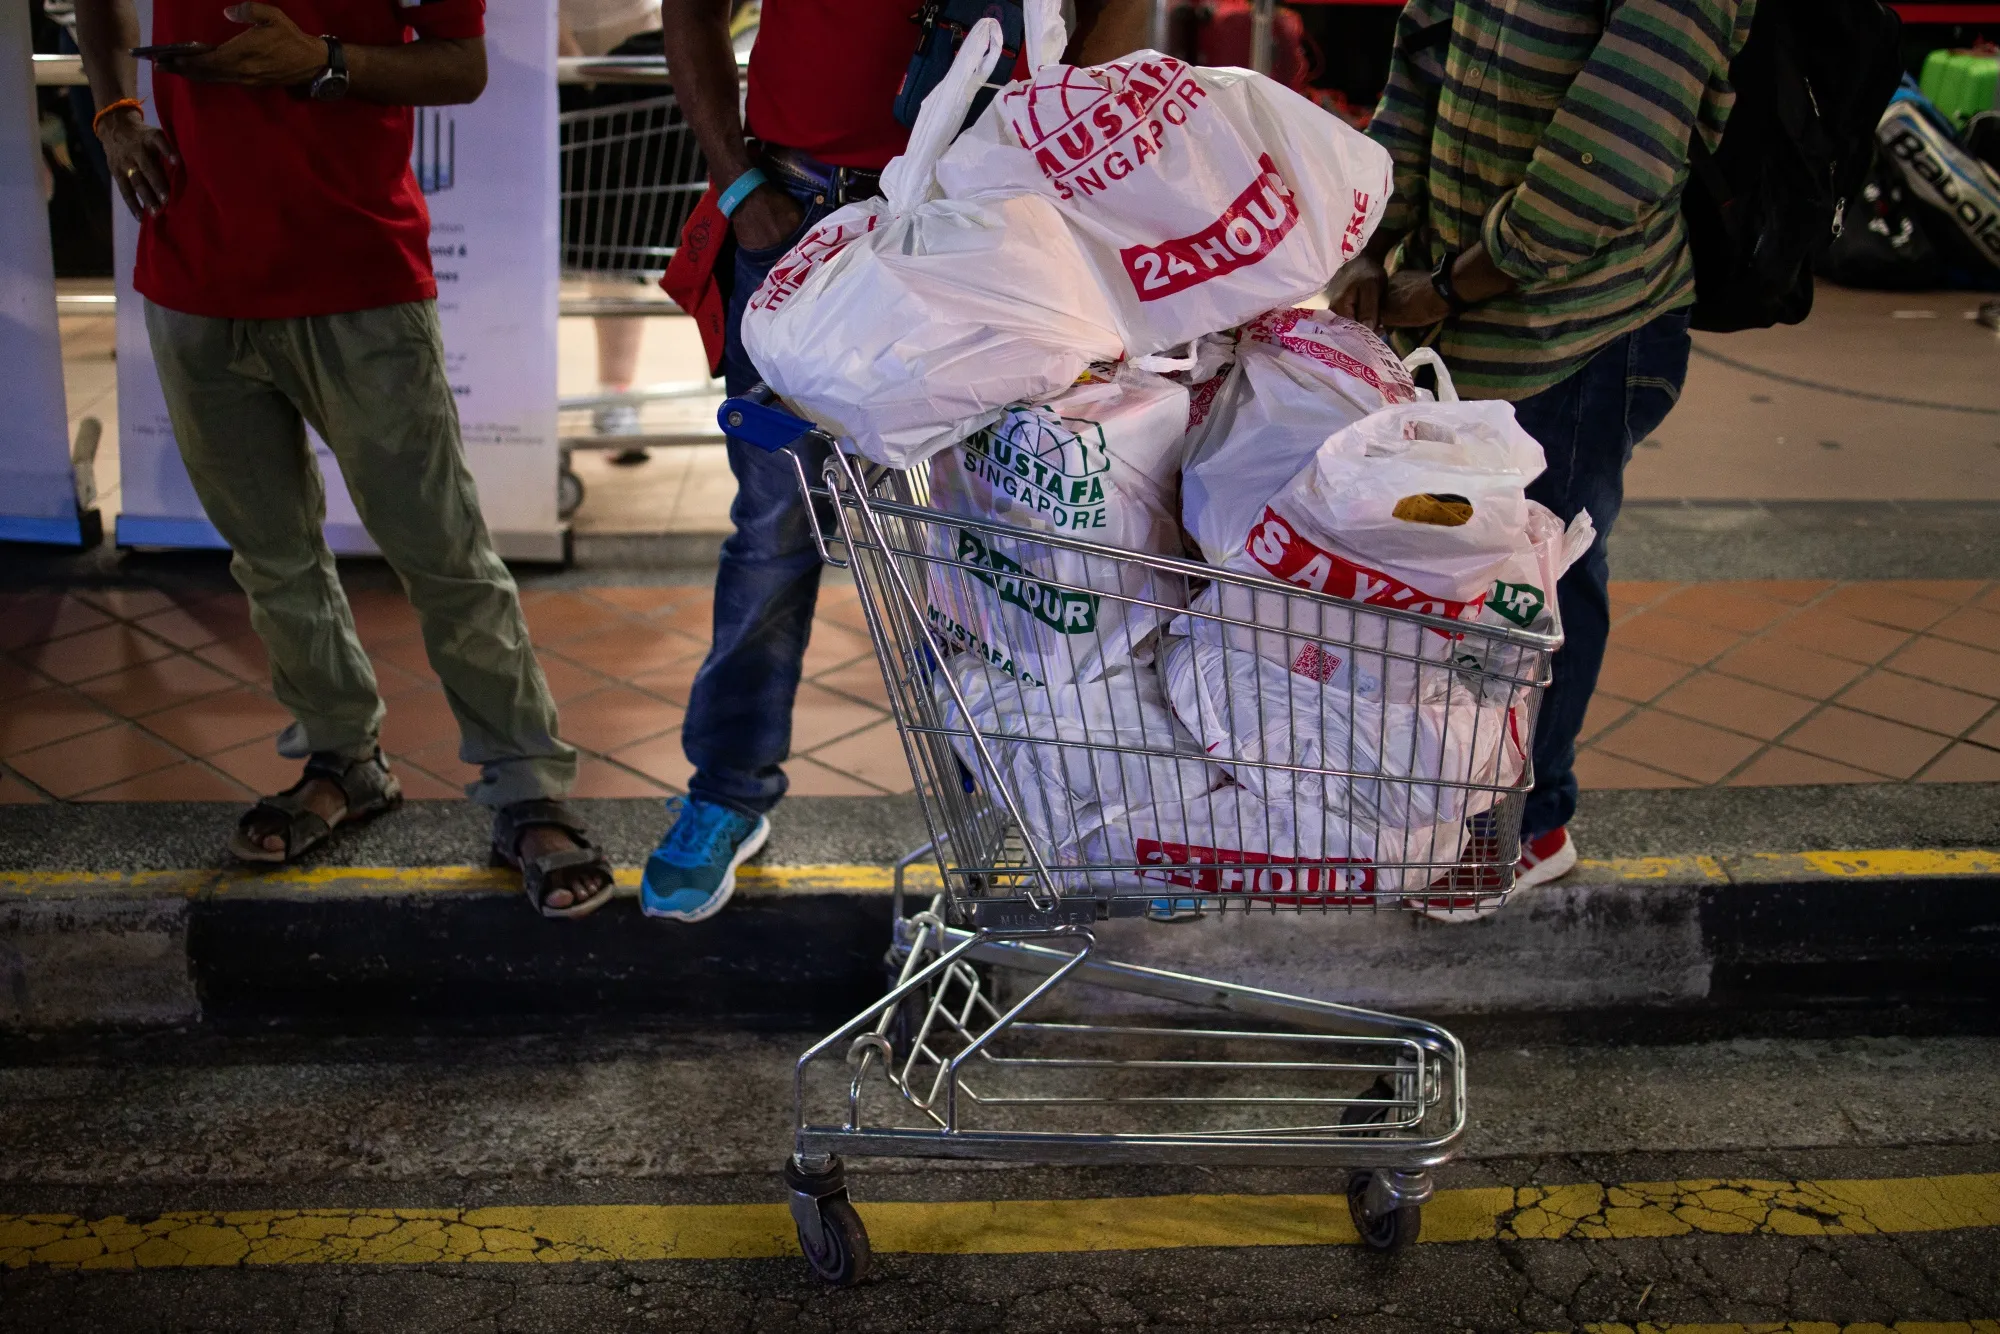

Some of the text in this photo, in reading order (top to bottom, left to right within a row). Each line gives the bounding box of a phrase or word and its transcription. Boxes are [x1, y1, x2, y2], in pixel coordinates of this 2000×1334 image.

[1054, 78, 1207, 200] SNGAPOR
[1341, 188, 1369, 261] TRE
[1891, 130, 2000, 255] Babola
[1134, 252, 1197, 292] 24
[963, 453, 1107, 530] SINGAPORE
[965, 427, 1105, 504] MUSTAFA
[998, 564, 1090, 627] HOUR
[927, 603, 1015, 677] MUSTAFA
[1142, 851, 1368, 899] 24 HOUR
